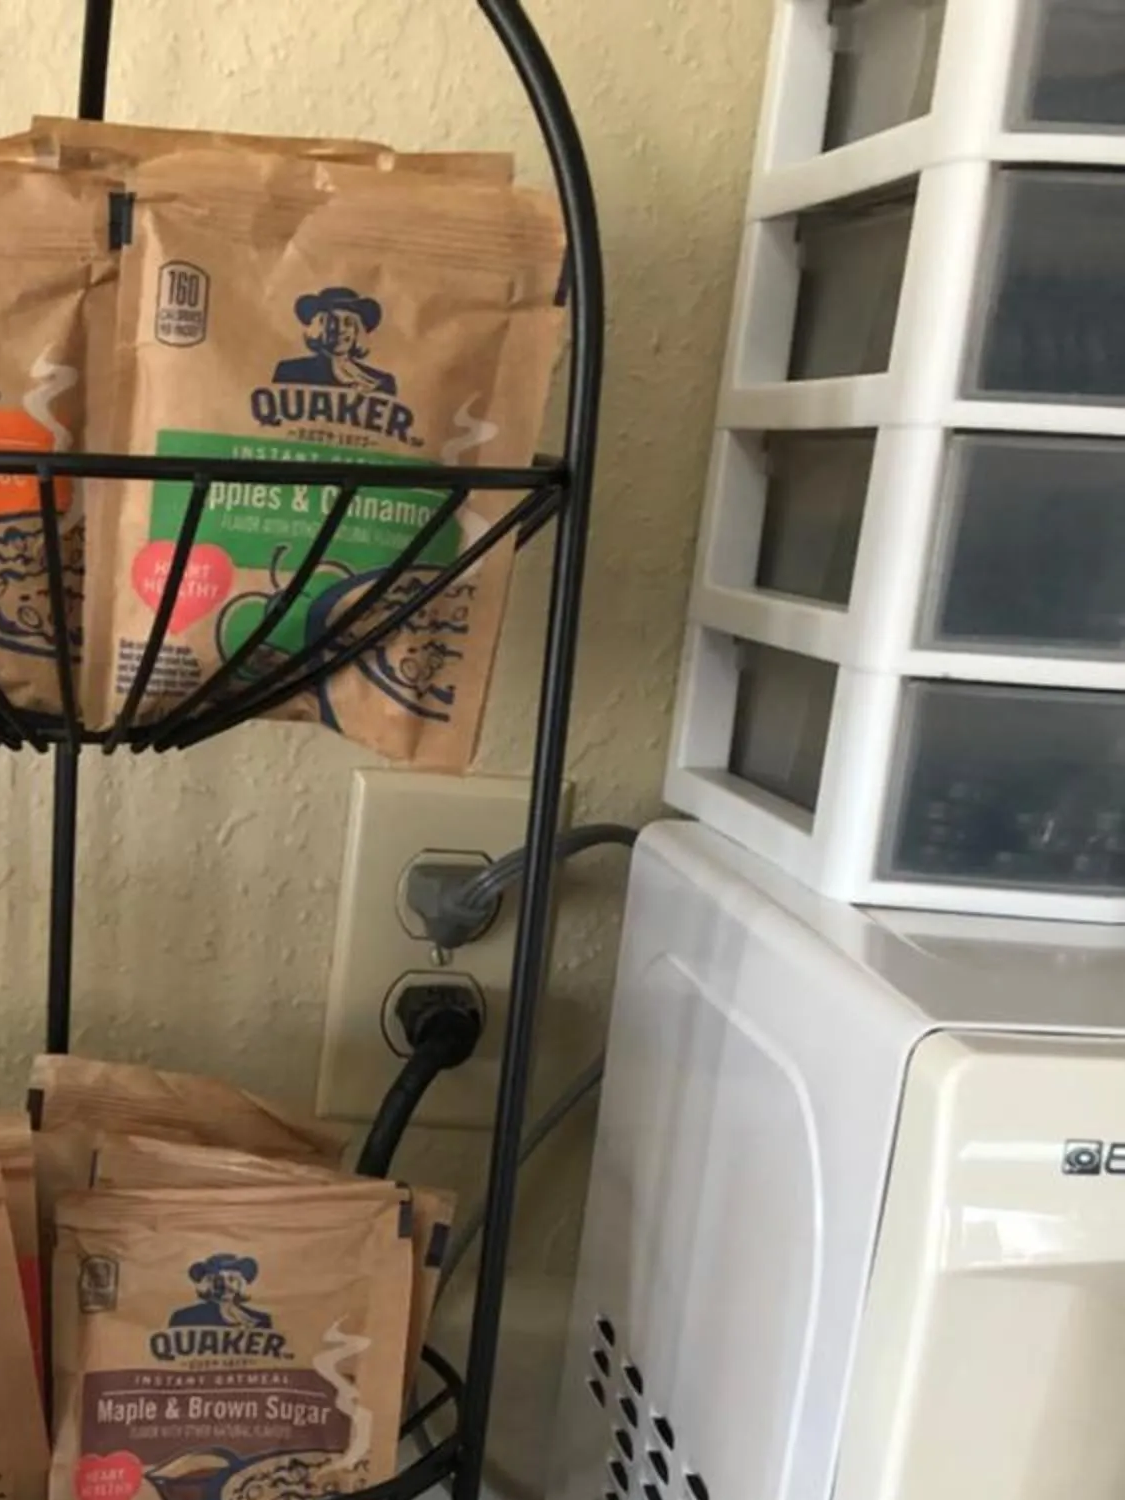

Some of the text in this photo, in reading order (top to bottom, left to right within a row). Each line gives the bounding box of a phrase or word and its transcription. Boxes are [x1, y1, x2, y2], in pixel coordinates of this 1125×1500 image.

[167, 270, 200, 307] 160
[250, 386, 415, 443] QUAKER
[207, 482, 431, 528] pples & Cnnamo
[150, 1329, 286, 1361] QUAKER
[97, 1396, 332, 1427] Maple & Brown Sugar
